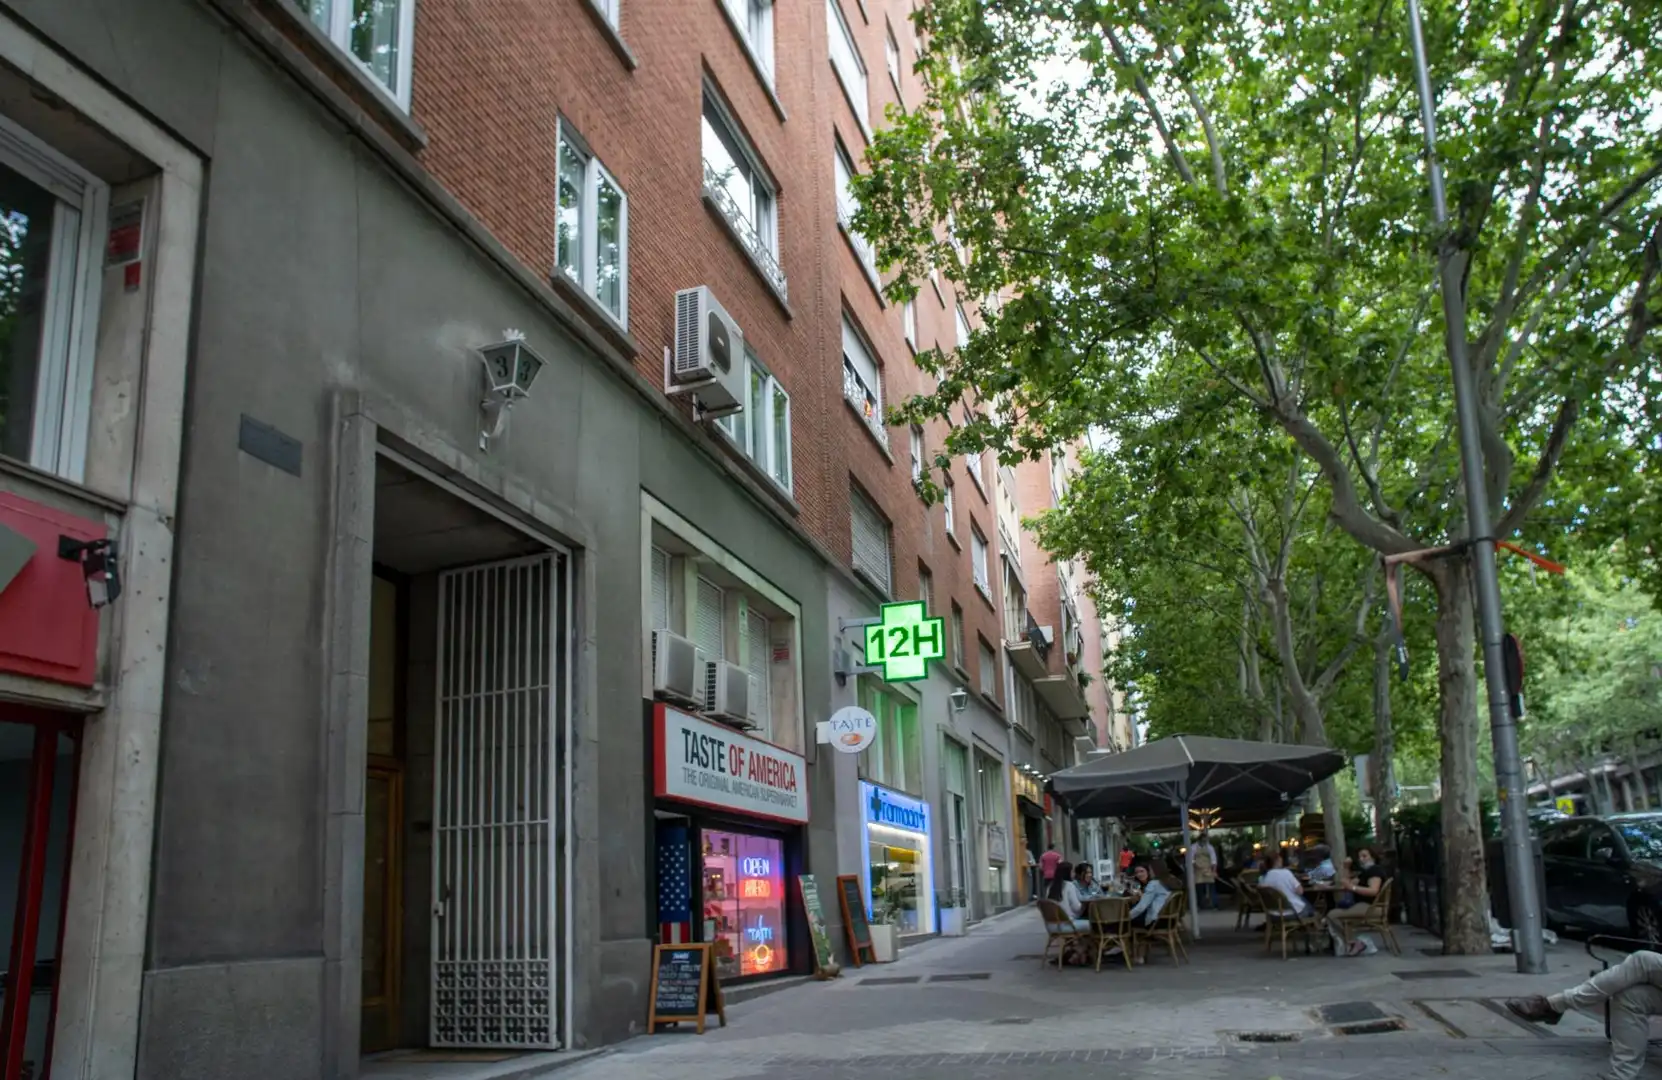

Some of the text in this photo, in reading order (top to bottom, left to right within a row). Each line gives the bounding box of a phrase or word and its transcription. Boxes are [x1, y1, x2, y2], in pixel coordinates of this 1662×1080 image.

[871, 623, 939, 659] 12H
[682, 727, 797, 793] TASTE OF AMERICA
[682, 767, 697, 786] THE
[743, 857, 770, 876] OPEN
